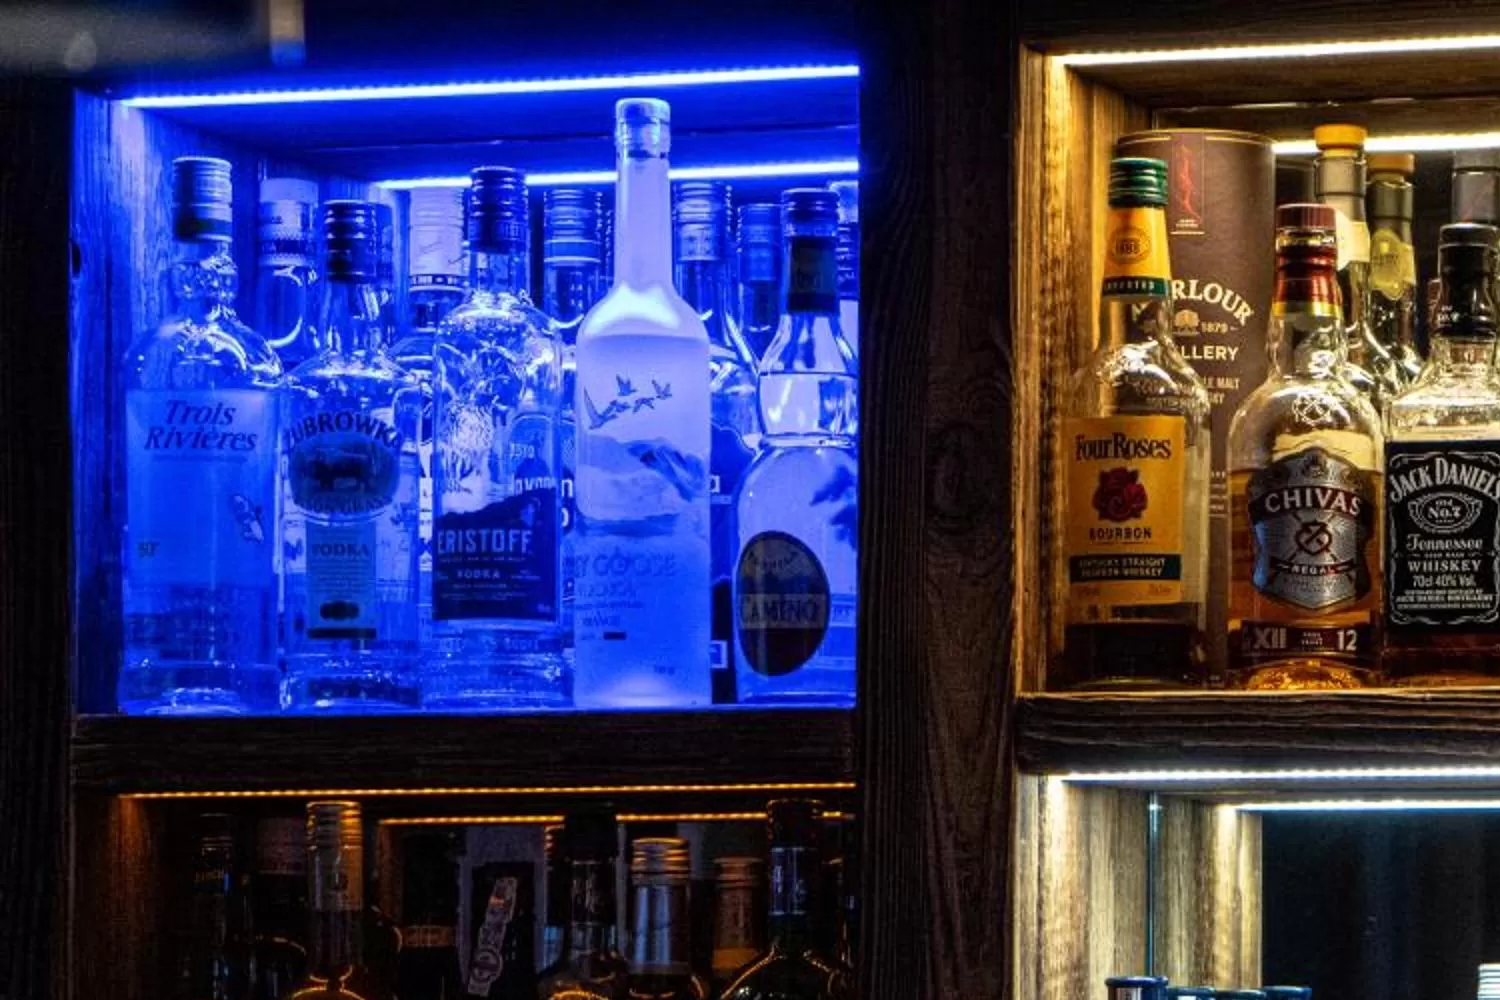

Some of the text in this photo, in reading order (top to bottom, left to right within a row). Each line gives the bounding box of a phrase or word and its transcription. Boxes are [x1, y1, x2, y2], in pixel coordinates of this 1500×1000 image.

[1171, 279, 1254, 327] RLOUR
[1181, 345, 1239, 361] LLERY
[164, 400, 236, 426] Trois
[144, 424, 257, 452] Rivières
[1389, 465, 1433, 502] JACK
[1264, 488, 1361, 516] CHIVAS
[437, 528, 534, 556] ERISTOFF
[1089, 527, 1152, 540] BOURBON
[1406, 534, 1484, 551] Tennessee
[1292, 565, 1336, 575] REGAL
[1408, 560, 1482, 573] WHISKEY
[1253, 628, 1287, 649] XII
[1337, 630, 1357, 651] 12
